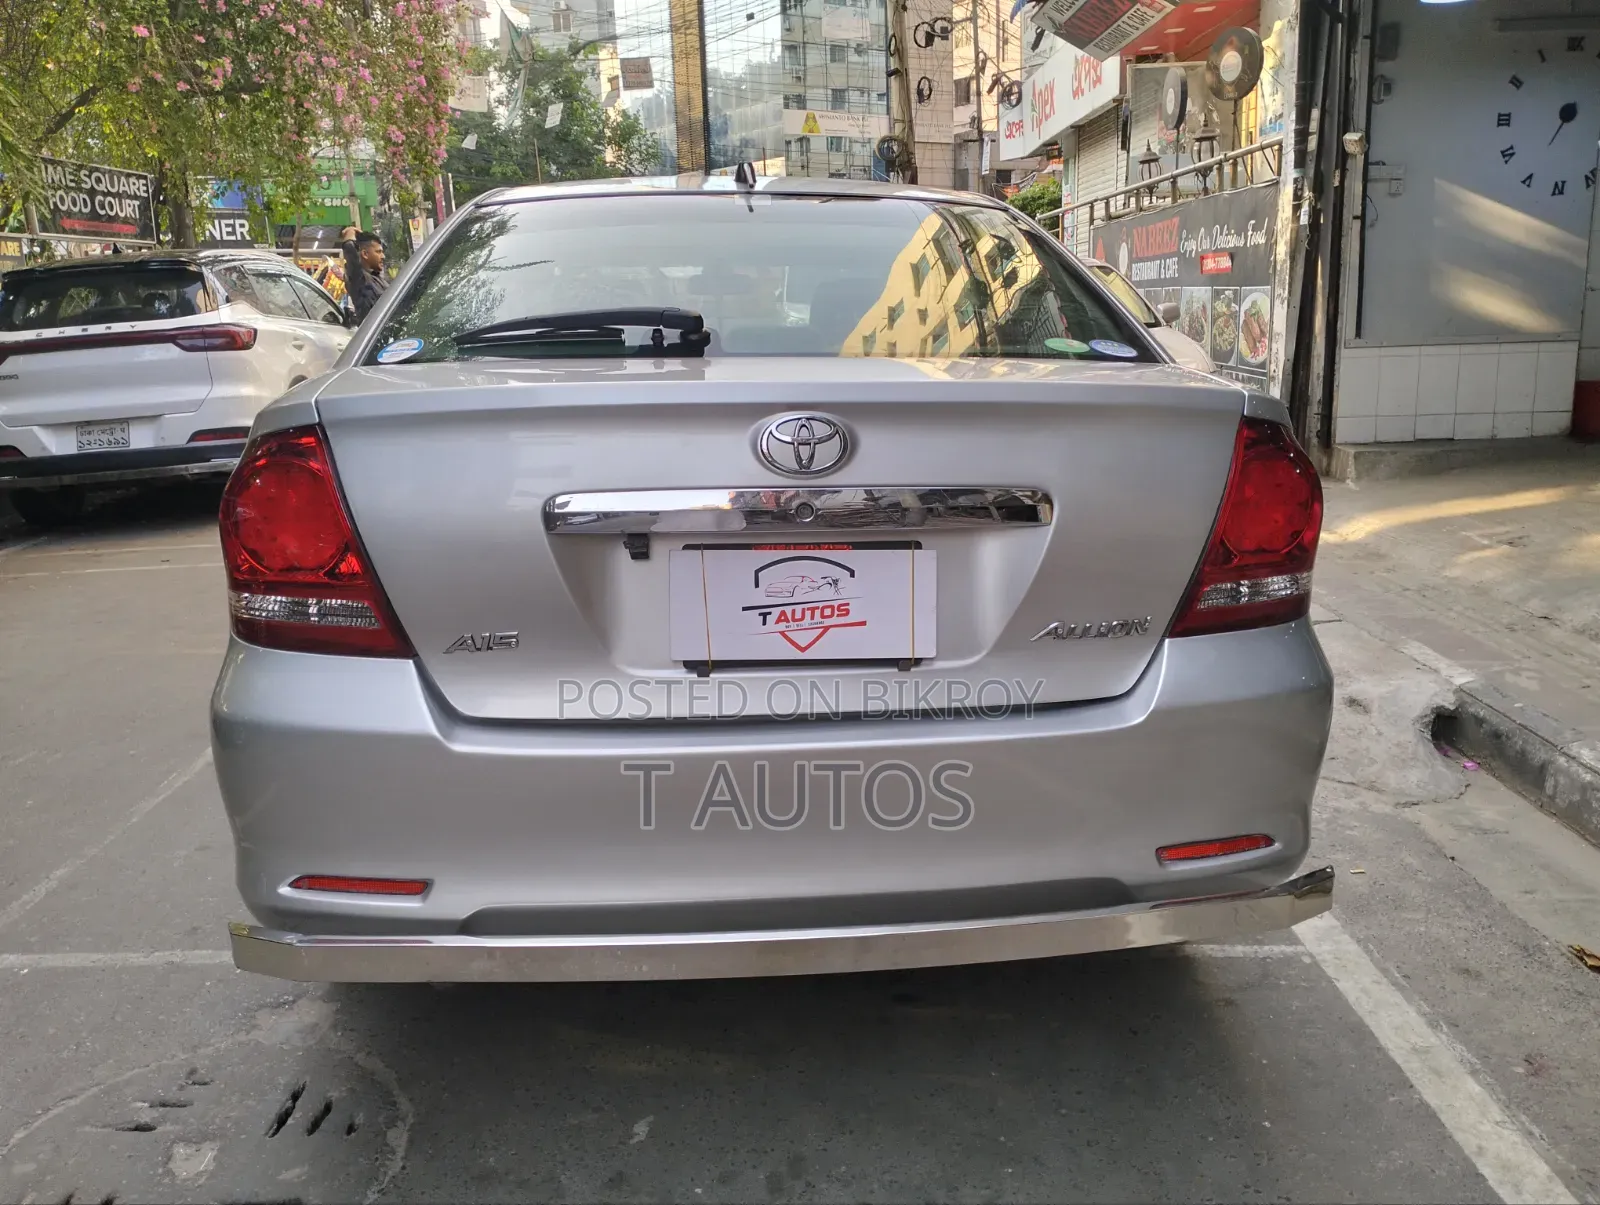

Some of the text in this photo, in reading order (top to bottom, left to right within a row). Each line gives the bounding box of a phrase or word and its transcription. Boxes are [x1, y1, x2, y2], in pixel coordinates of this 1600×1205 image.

[1030, 78, 1056, 140] Apex
[39, 162, 148, 197] IME SQUARE
[95, 195, 140, 218] COURT
[325, 197, 360, 207] SHO
[201, 219, 251, 241] NER
[1180, 217, 1269, 258] Enjoy Our Delicious Food
[1131, 257, 1179, 281] RESTAURANT & CAFE
[35, 324, 137, 338] CHERY
[758, 602, 851, 626] T AUTOS
[1029, 615, 1152, 641] ALLION
[442, 631, 520, 654] A15
